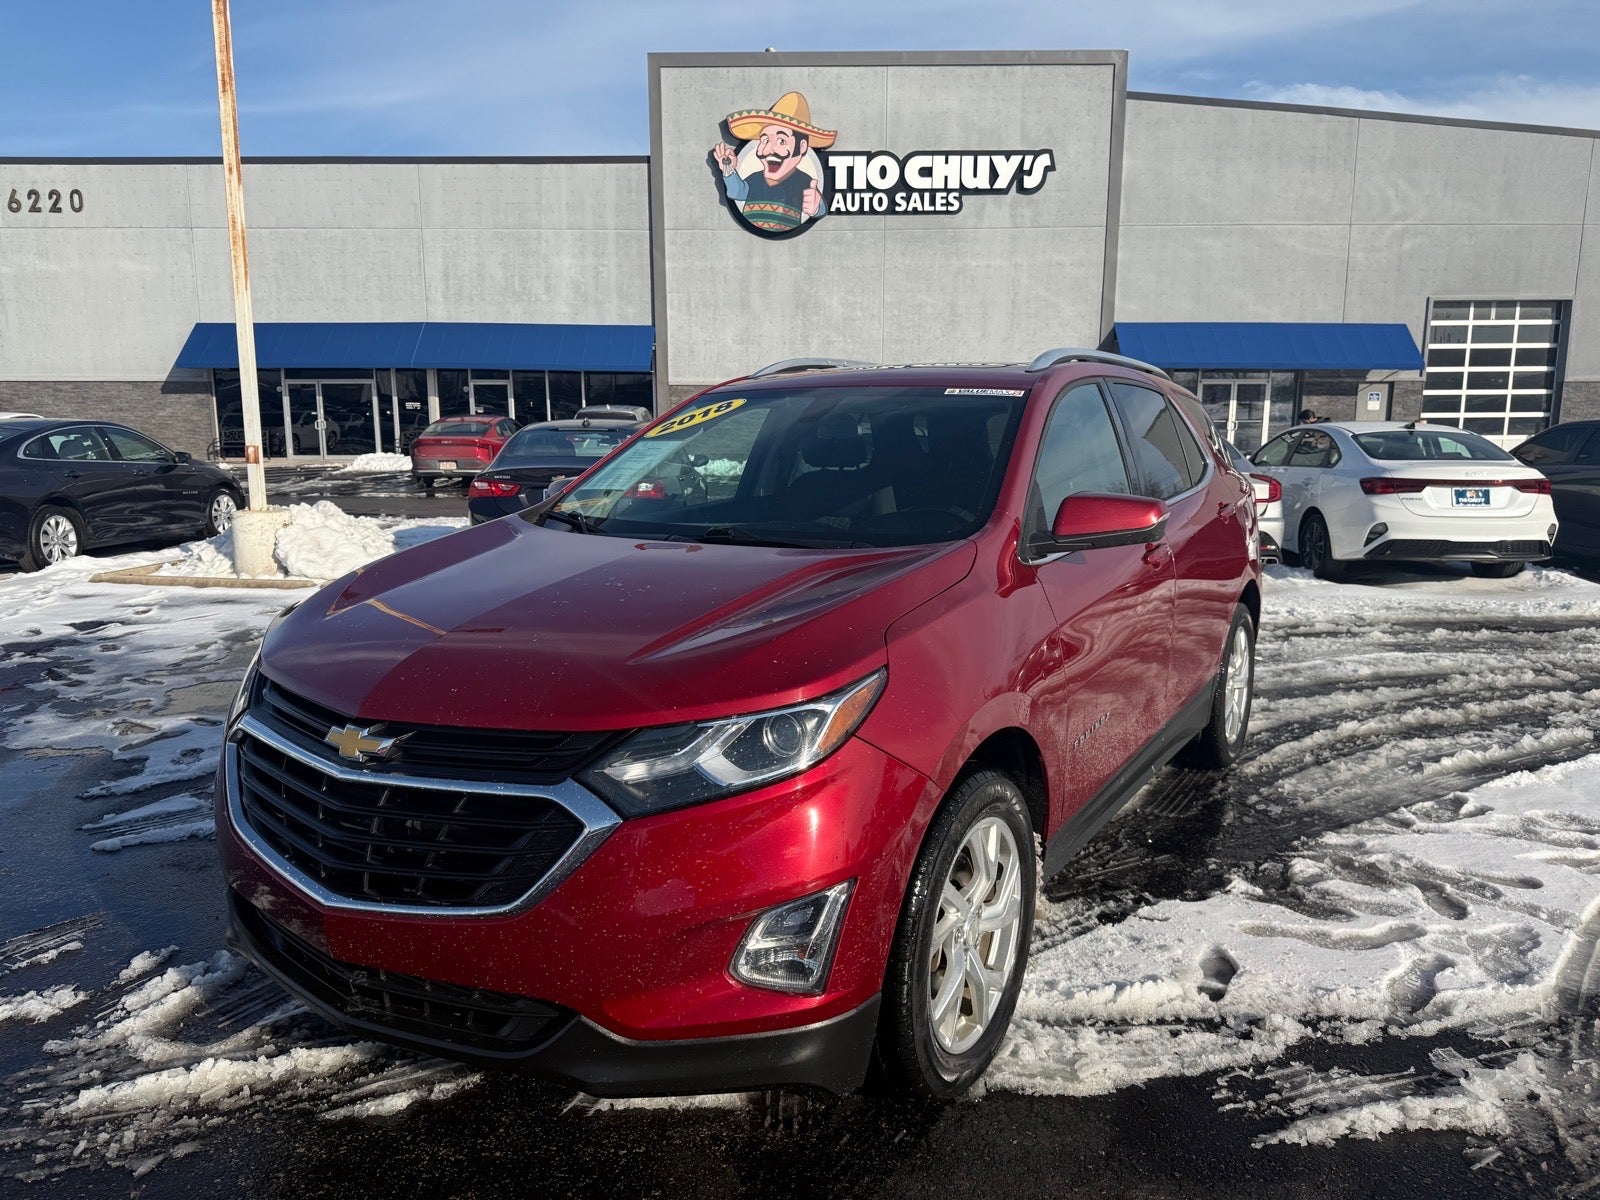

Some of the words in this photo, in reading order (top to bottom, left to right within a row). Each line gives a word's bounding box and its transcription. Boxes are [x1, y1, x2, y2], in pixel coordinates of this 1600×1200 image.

[828, 155, 900, 190] TIO
[904, 153, 1051, 190] CHUY'S
[7, 188, 84, 213] 6220
[829, 192, 888, 212] AUTO
[894, 192, 960, 212] SALES
[655, 401, 734, 435] 2018
